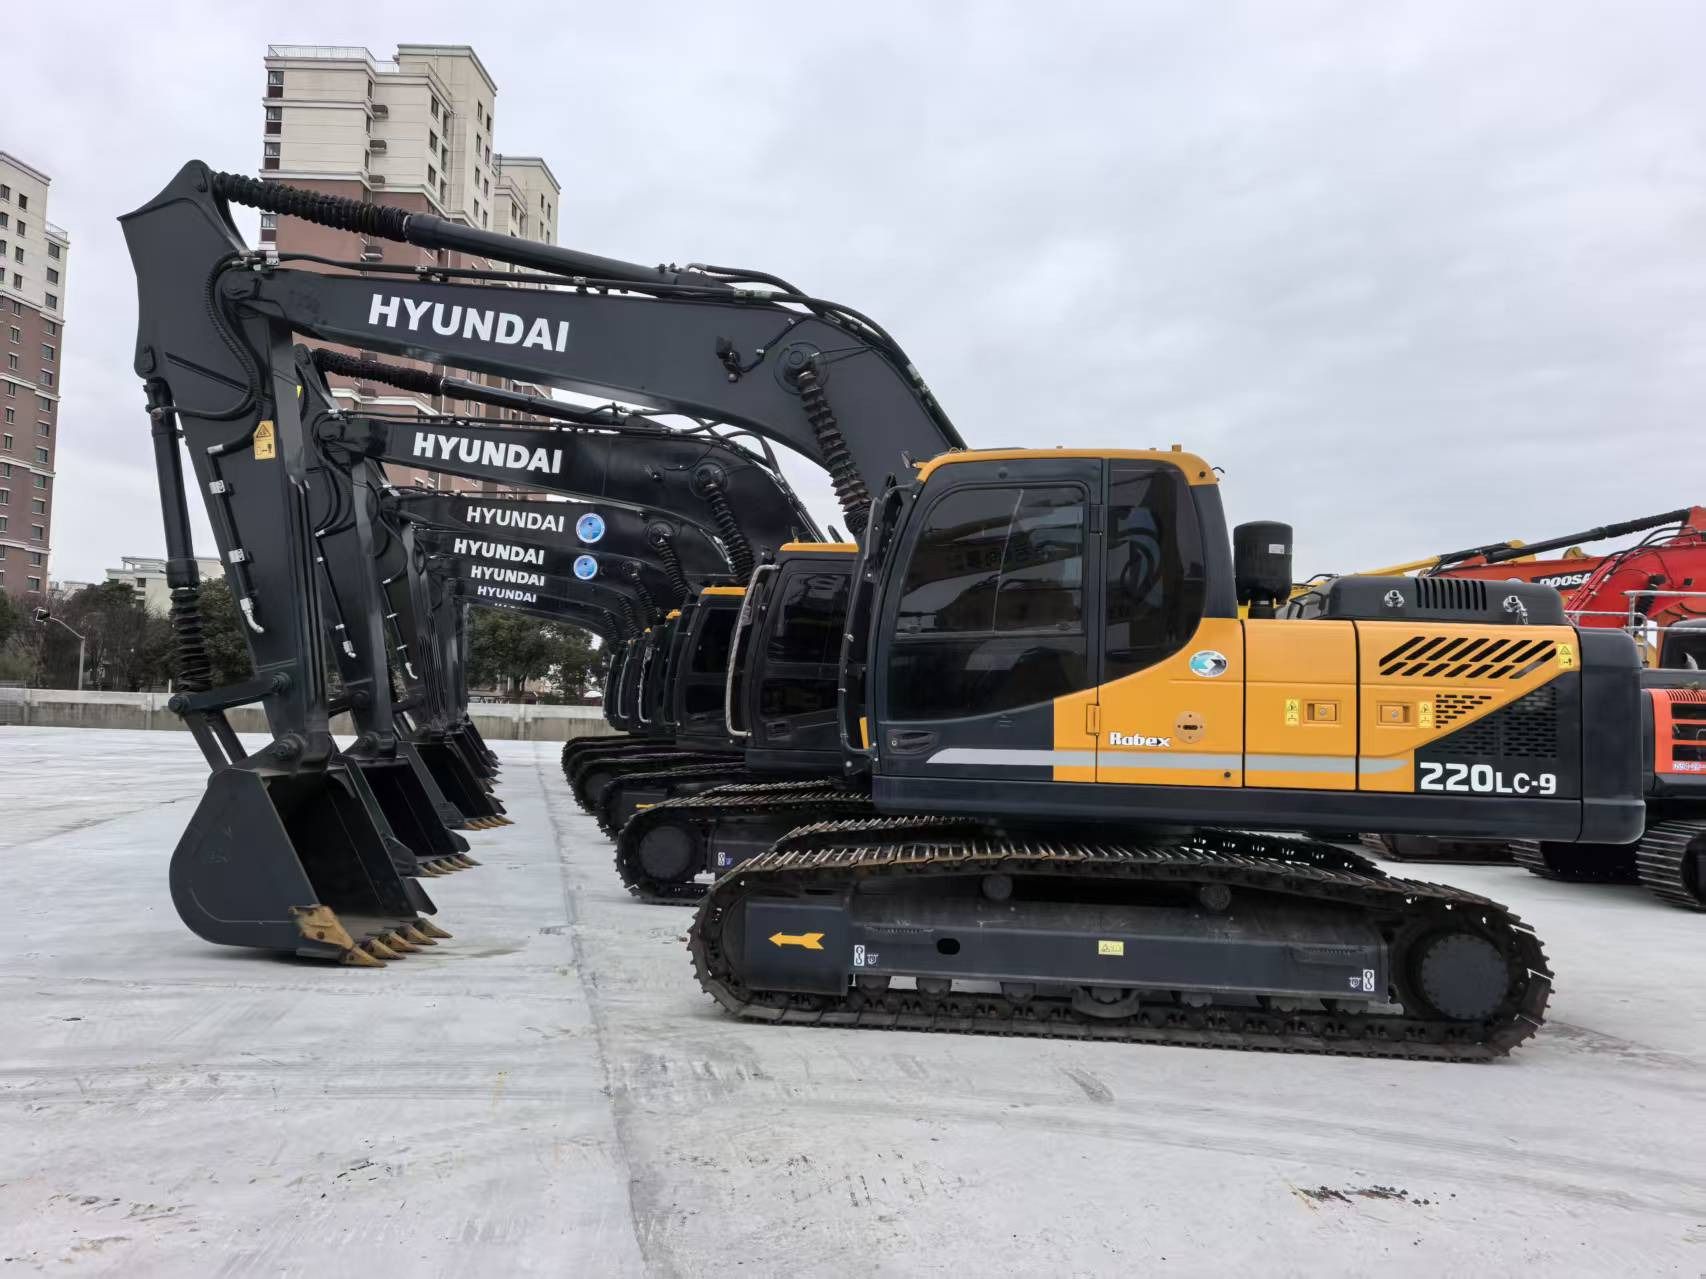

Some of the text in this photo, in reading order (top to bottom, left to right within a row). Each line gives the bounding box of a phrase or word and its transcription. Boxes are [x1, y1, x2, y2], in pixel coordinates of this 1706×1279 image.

[368, 294, 570, 352] HYUNDAI
[413, 432, 563, 474] HYUNDAI
[466, 505, 565, 533] HYUNDAI
[453, 538, 545, 565] HYUNDAI
[470, 565, 545, 587] HYUNDAI
[477, 585, 537, 603] HYUNDAI
